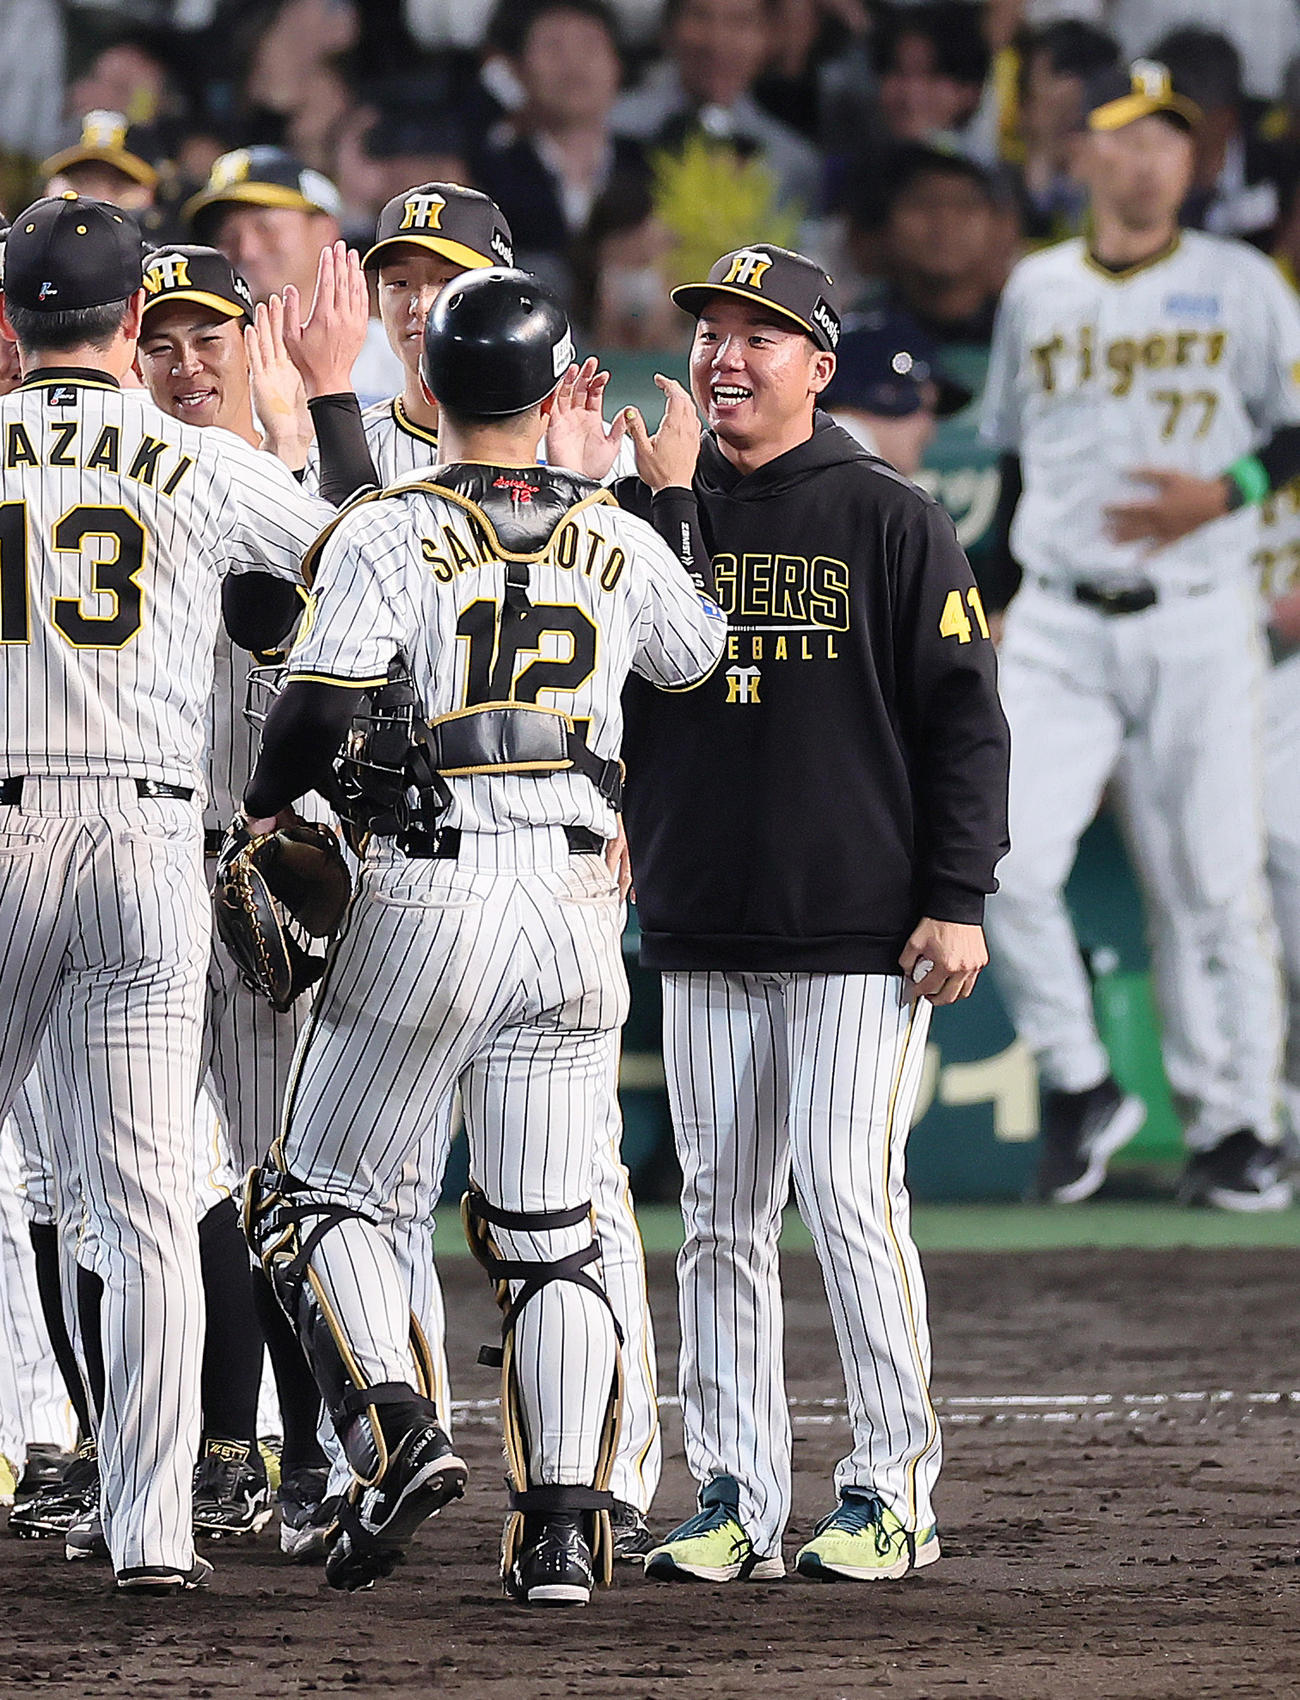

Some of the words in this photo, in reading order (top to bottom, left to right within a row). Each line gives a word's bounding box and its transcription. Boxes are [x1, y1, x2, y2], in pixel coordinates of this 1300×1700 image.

[1154, 389, 1220, 441] 77
[0, 499, 147, 649] 13
[420, 514, 627, 593] SAKOTO
[940, 587, 991, 644] 41
[455, 598, 600, 736] 12
